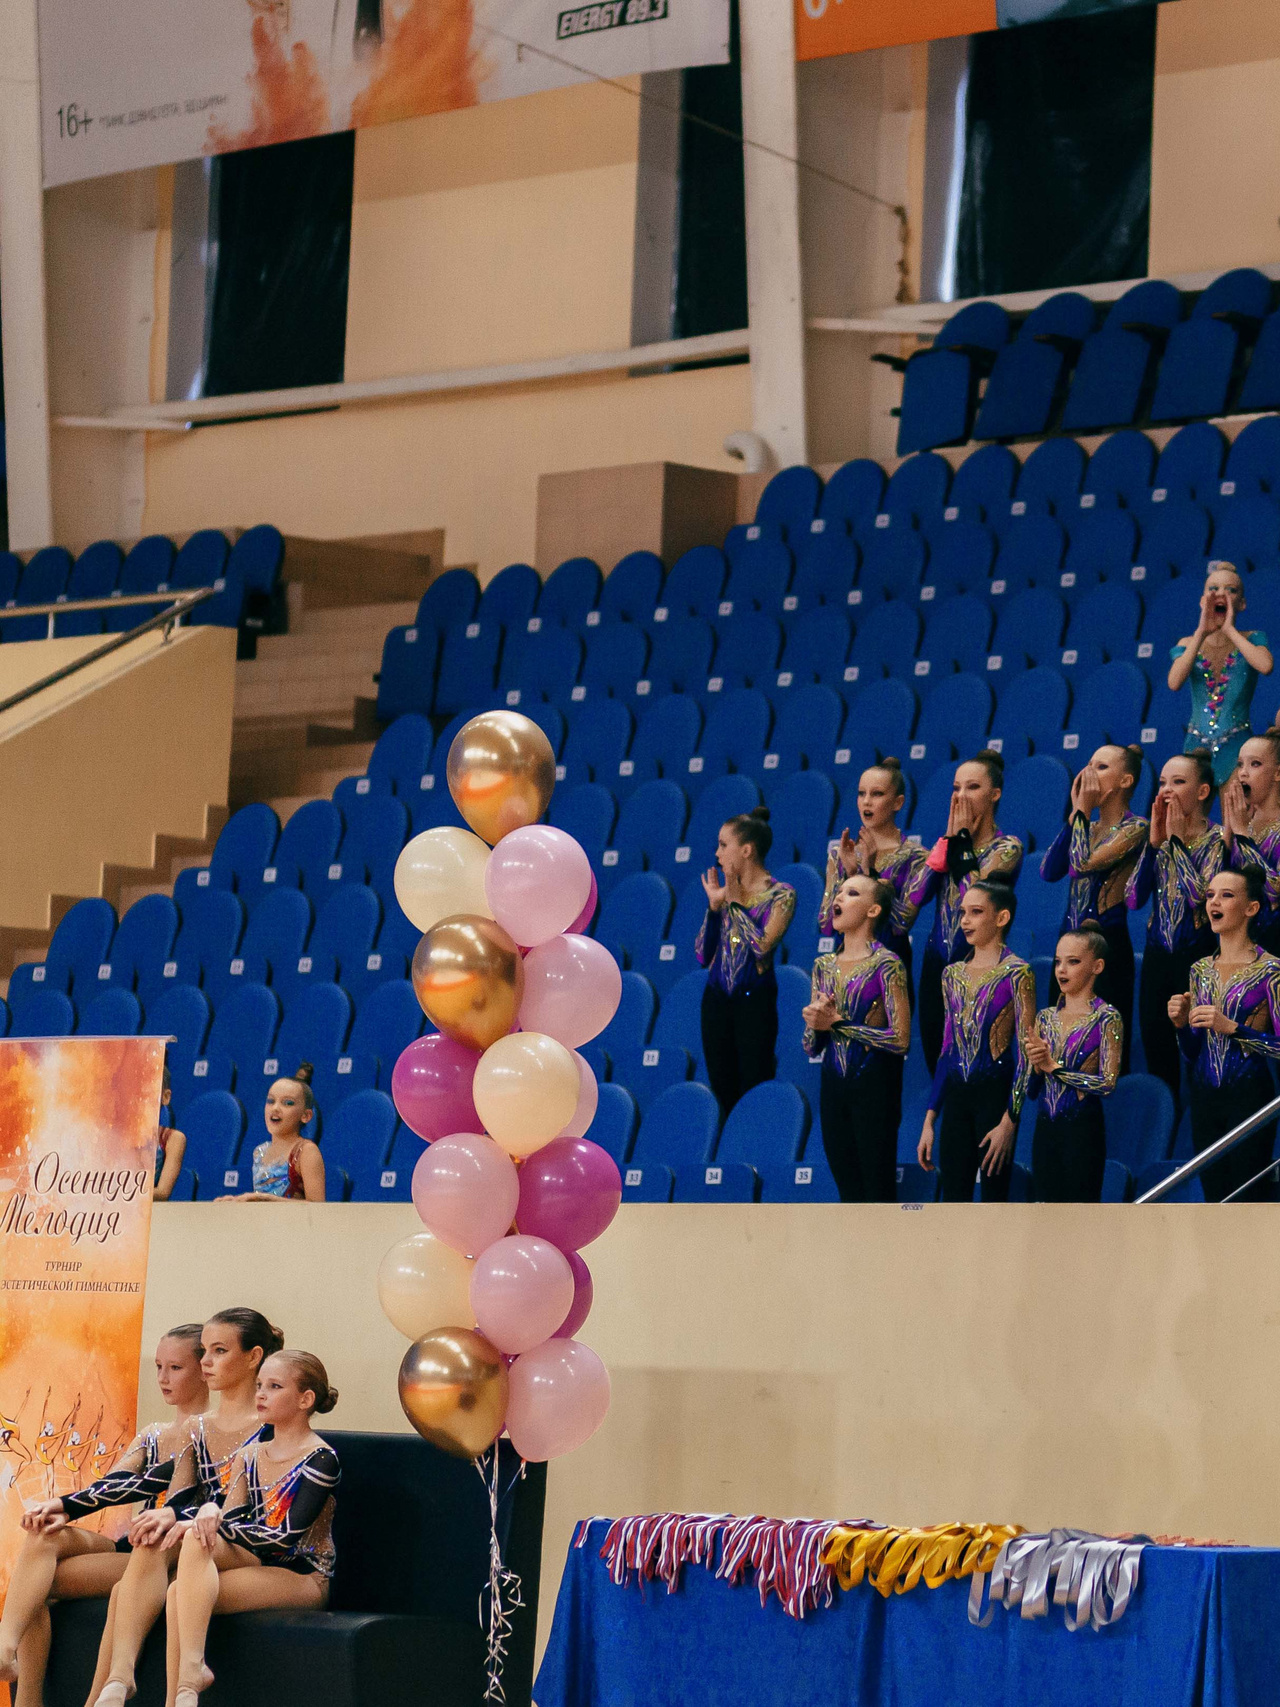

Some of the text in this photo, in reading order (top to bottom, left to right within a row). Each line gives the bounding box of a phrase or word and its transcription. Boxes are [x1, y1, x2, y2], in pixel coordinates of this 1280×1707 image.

[56, 102, 93, 138] 16+
[34, 1151, 149, 1202] Осенняя
[0, 1193, 122, 1246] Мелодия
[45, 1261, 82, 1272] ТУРНИР
[1, 1278, 141, 1293] ЭСТЕТИЧЕСКОЙ ГИМНАСТИКЕ
